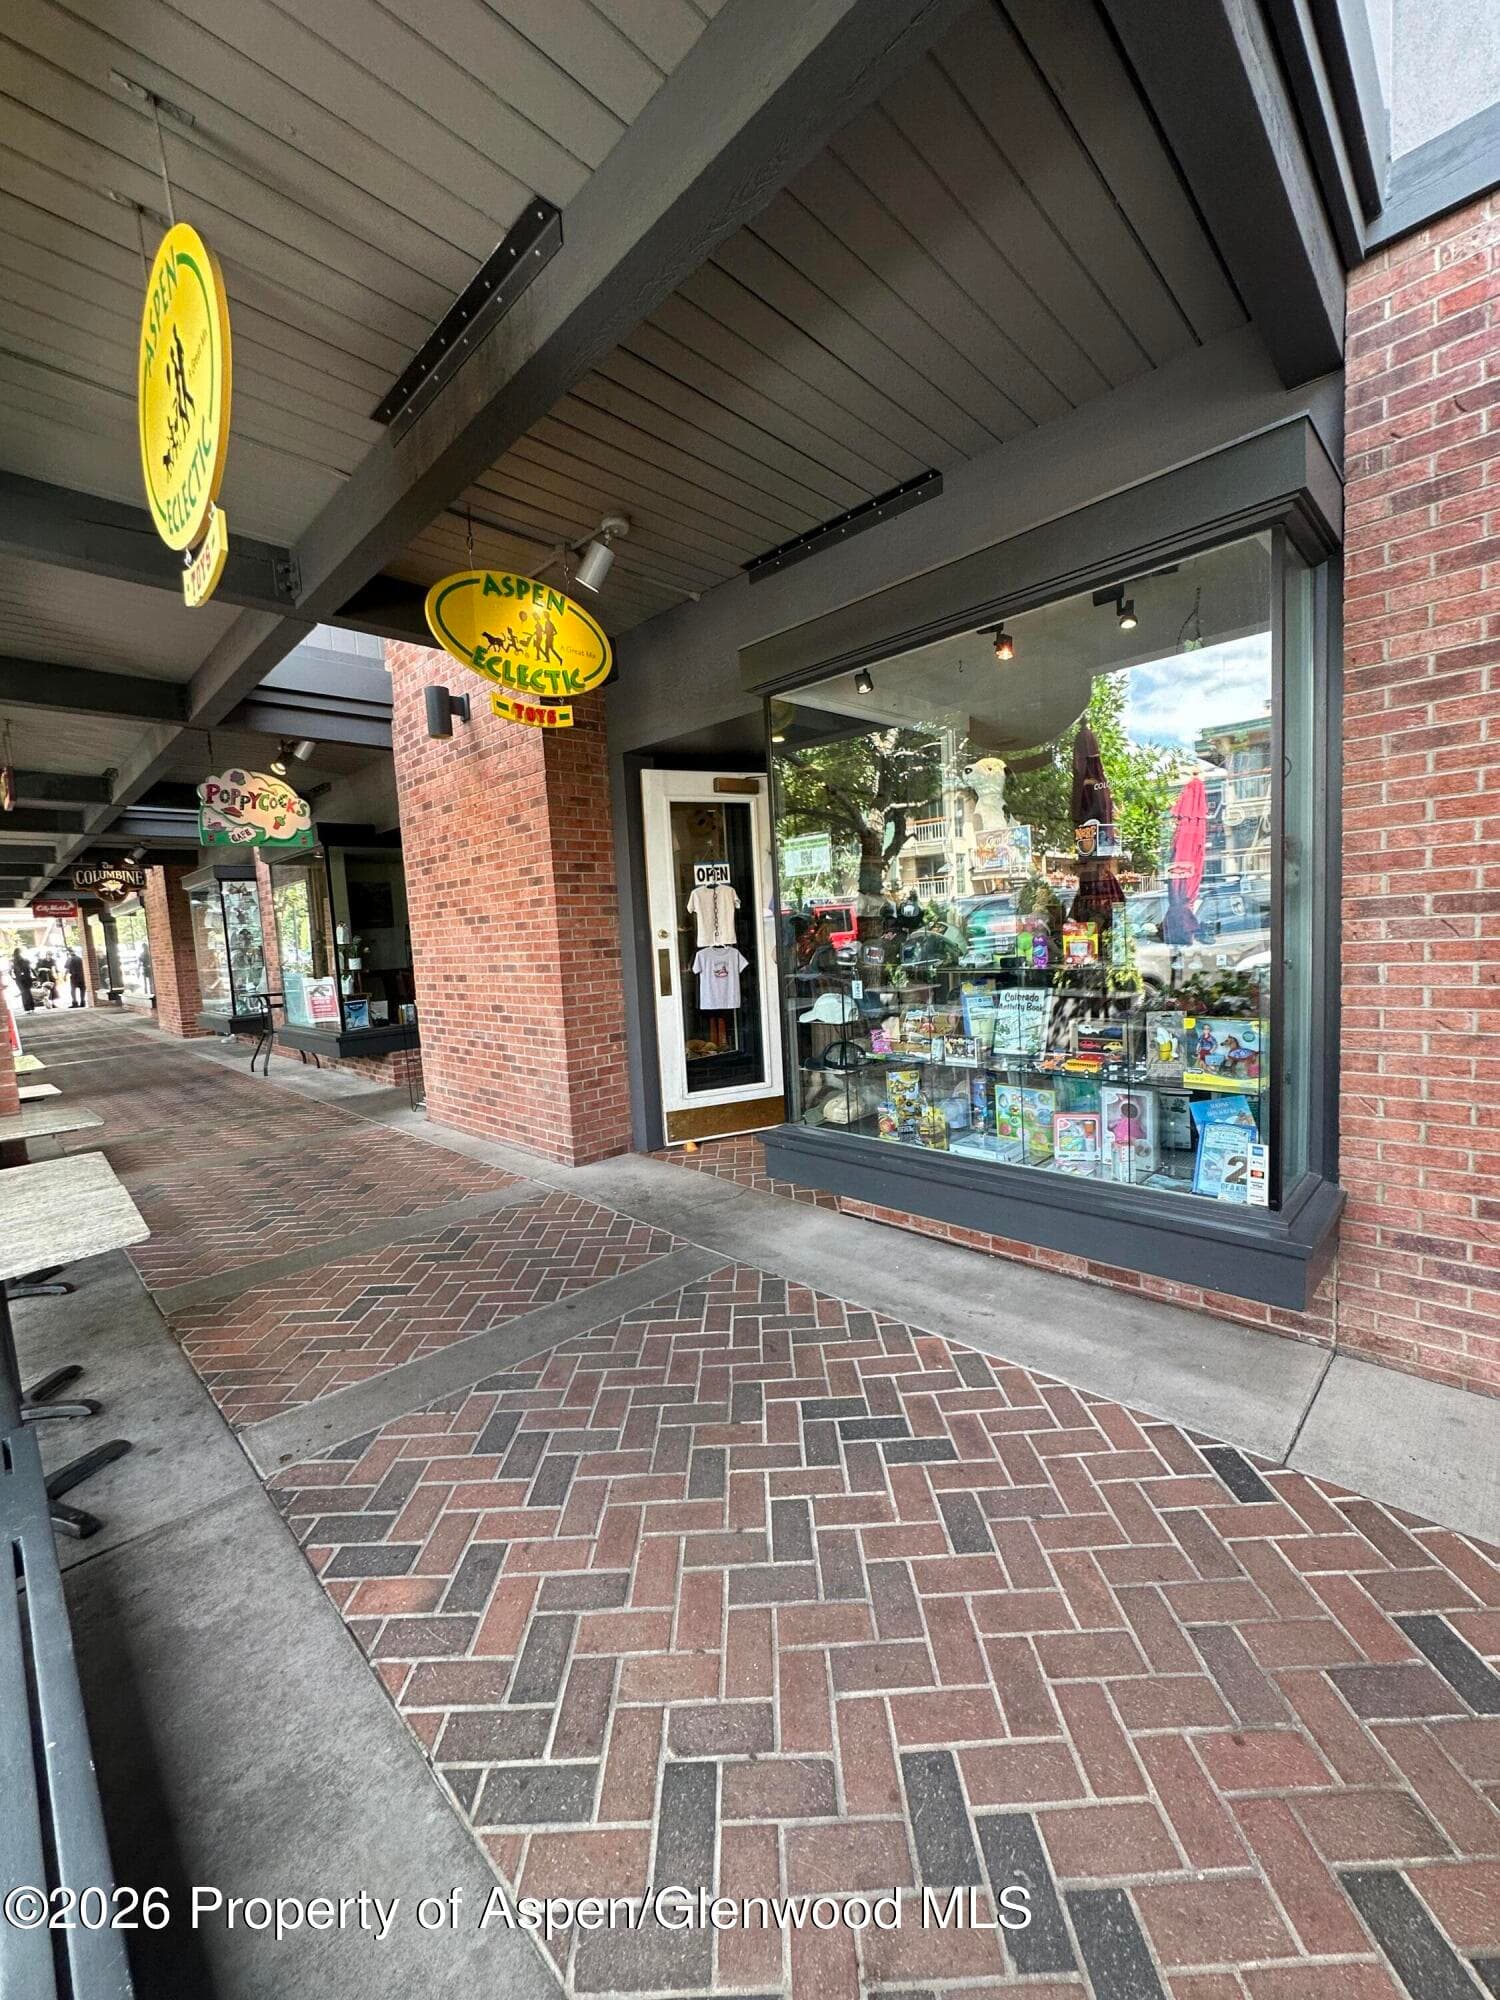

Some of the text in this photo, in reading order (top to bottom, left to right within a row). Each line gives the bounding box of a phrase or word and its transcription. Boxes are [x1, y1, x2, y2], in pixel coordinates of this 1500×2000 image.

[145, 245, 179, 378] ASPEN
[165, 420, 213, 536] ECLECTIC
[190, 550, 213, 597] TOYS
[482, 573, 566, 616] ASPEN
[472, 645, 586, 693] ECLECTIC
[512, 703, 557, 725] TOYS
[205, 783, 308, 817] POPPYCOCK'S
[75, 870, 144, 886] COLUMBINE
[697, 866, 729, 882] OPEN
[1005, 992, 1039, 1002] Colorado
[1026, 1002, 1042, 1011] Book
[1224, 1155, 1248, 1185] 2
